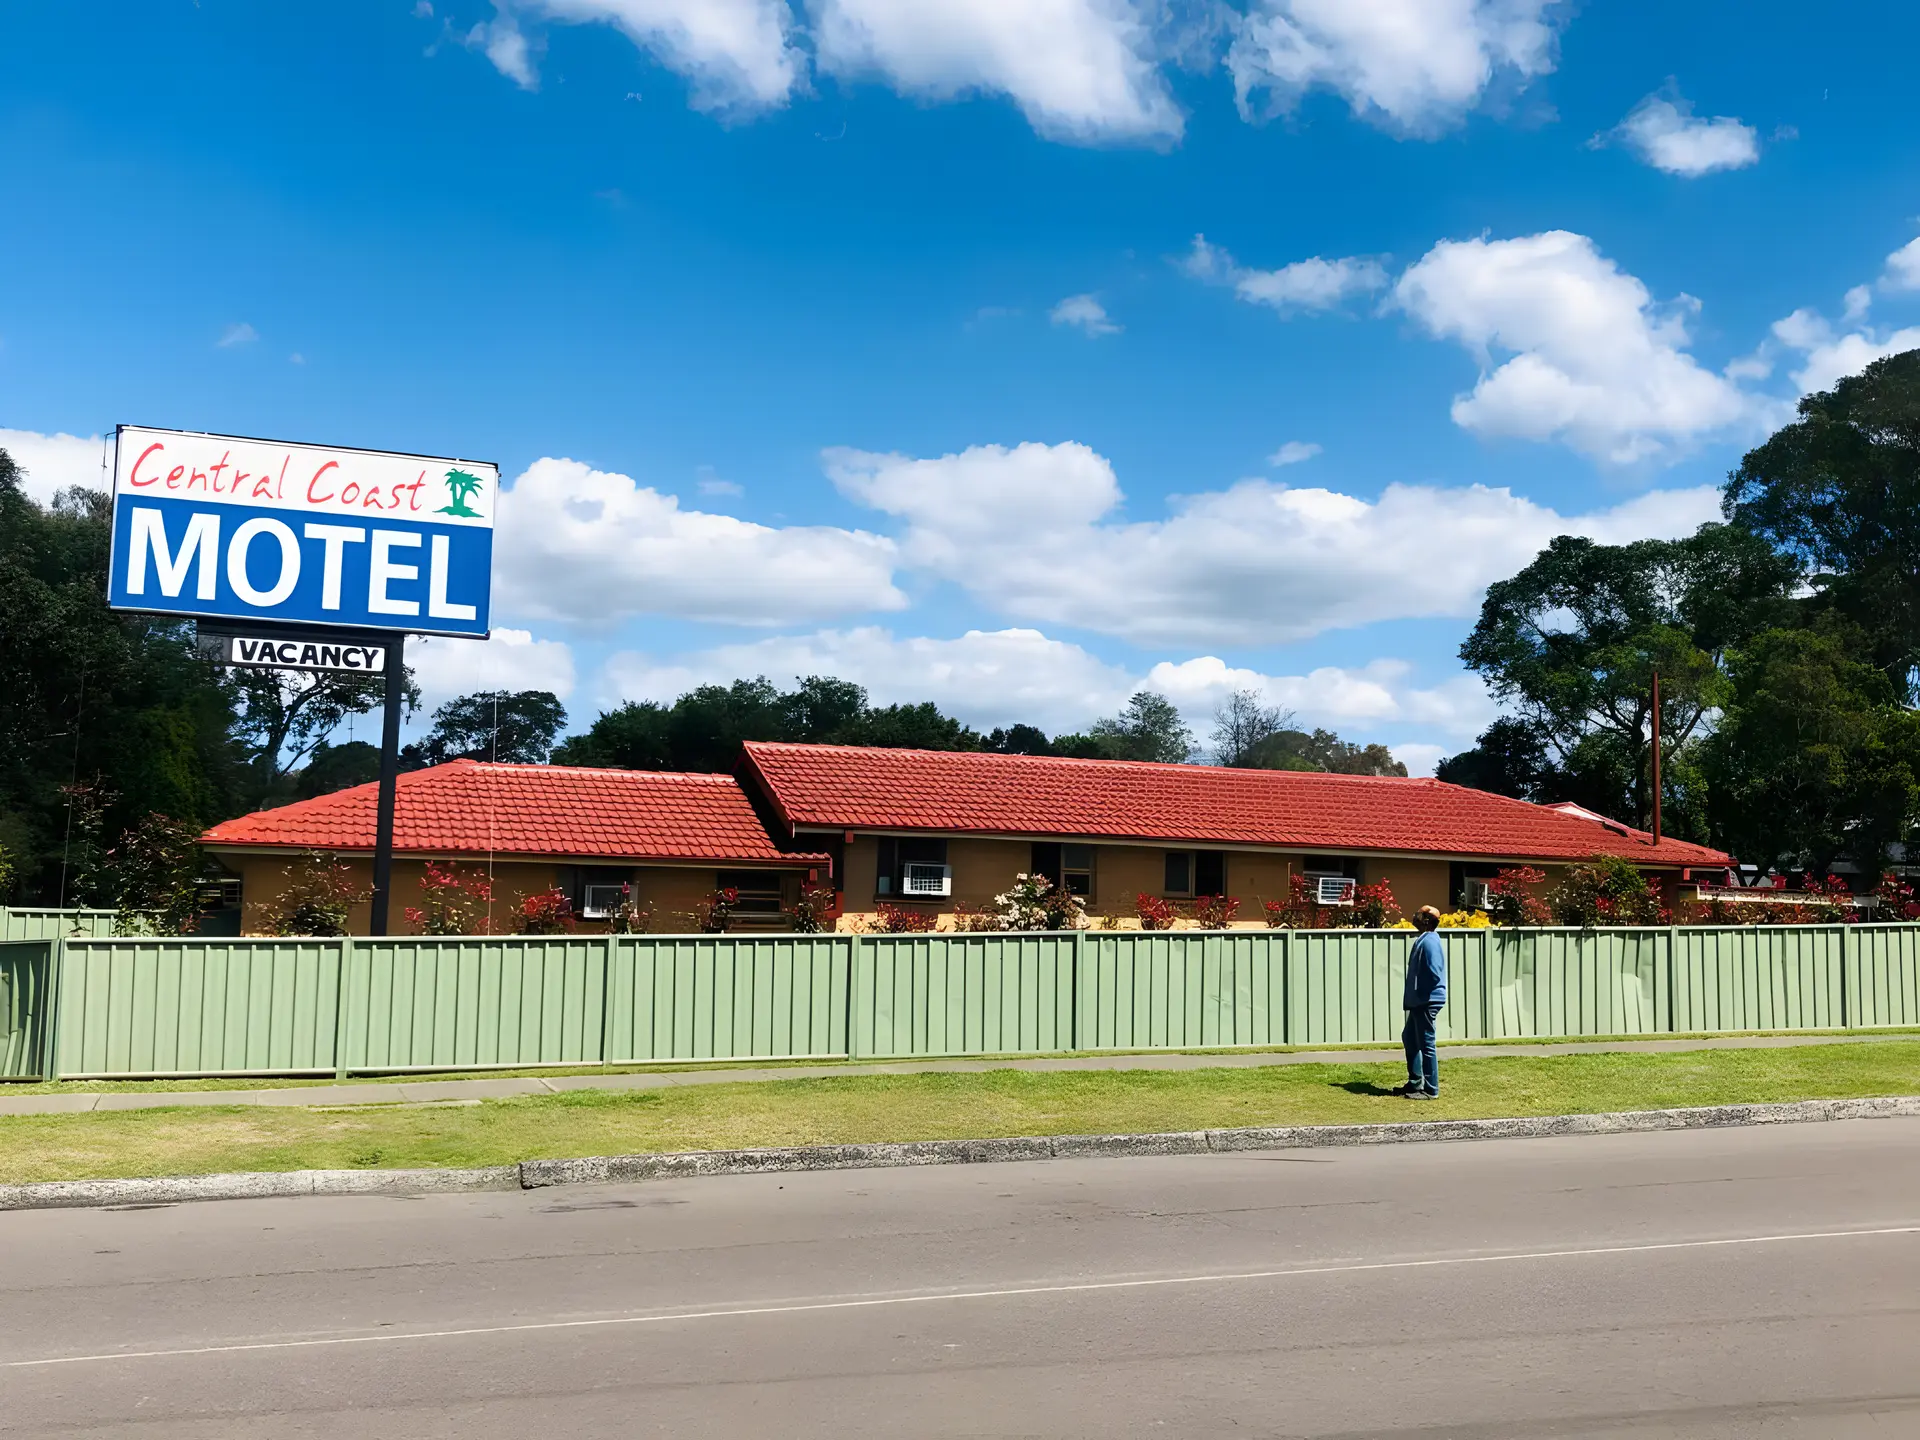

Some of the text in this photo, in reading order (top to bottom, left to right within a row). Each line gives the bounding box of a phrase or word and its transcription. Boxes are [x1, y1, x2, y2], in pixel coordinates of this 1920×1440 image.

[130, 443, 426, 511] Central Coast
[126, 506, 477, 621] MOTEL
[238, 640, 380, 669] VACANCY
